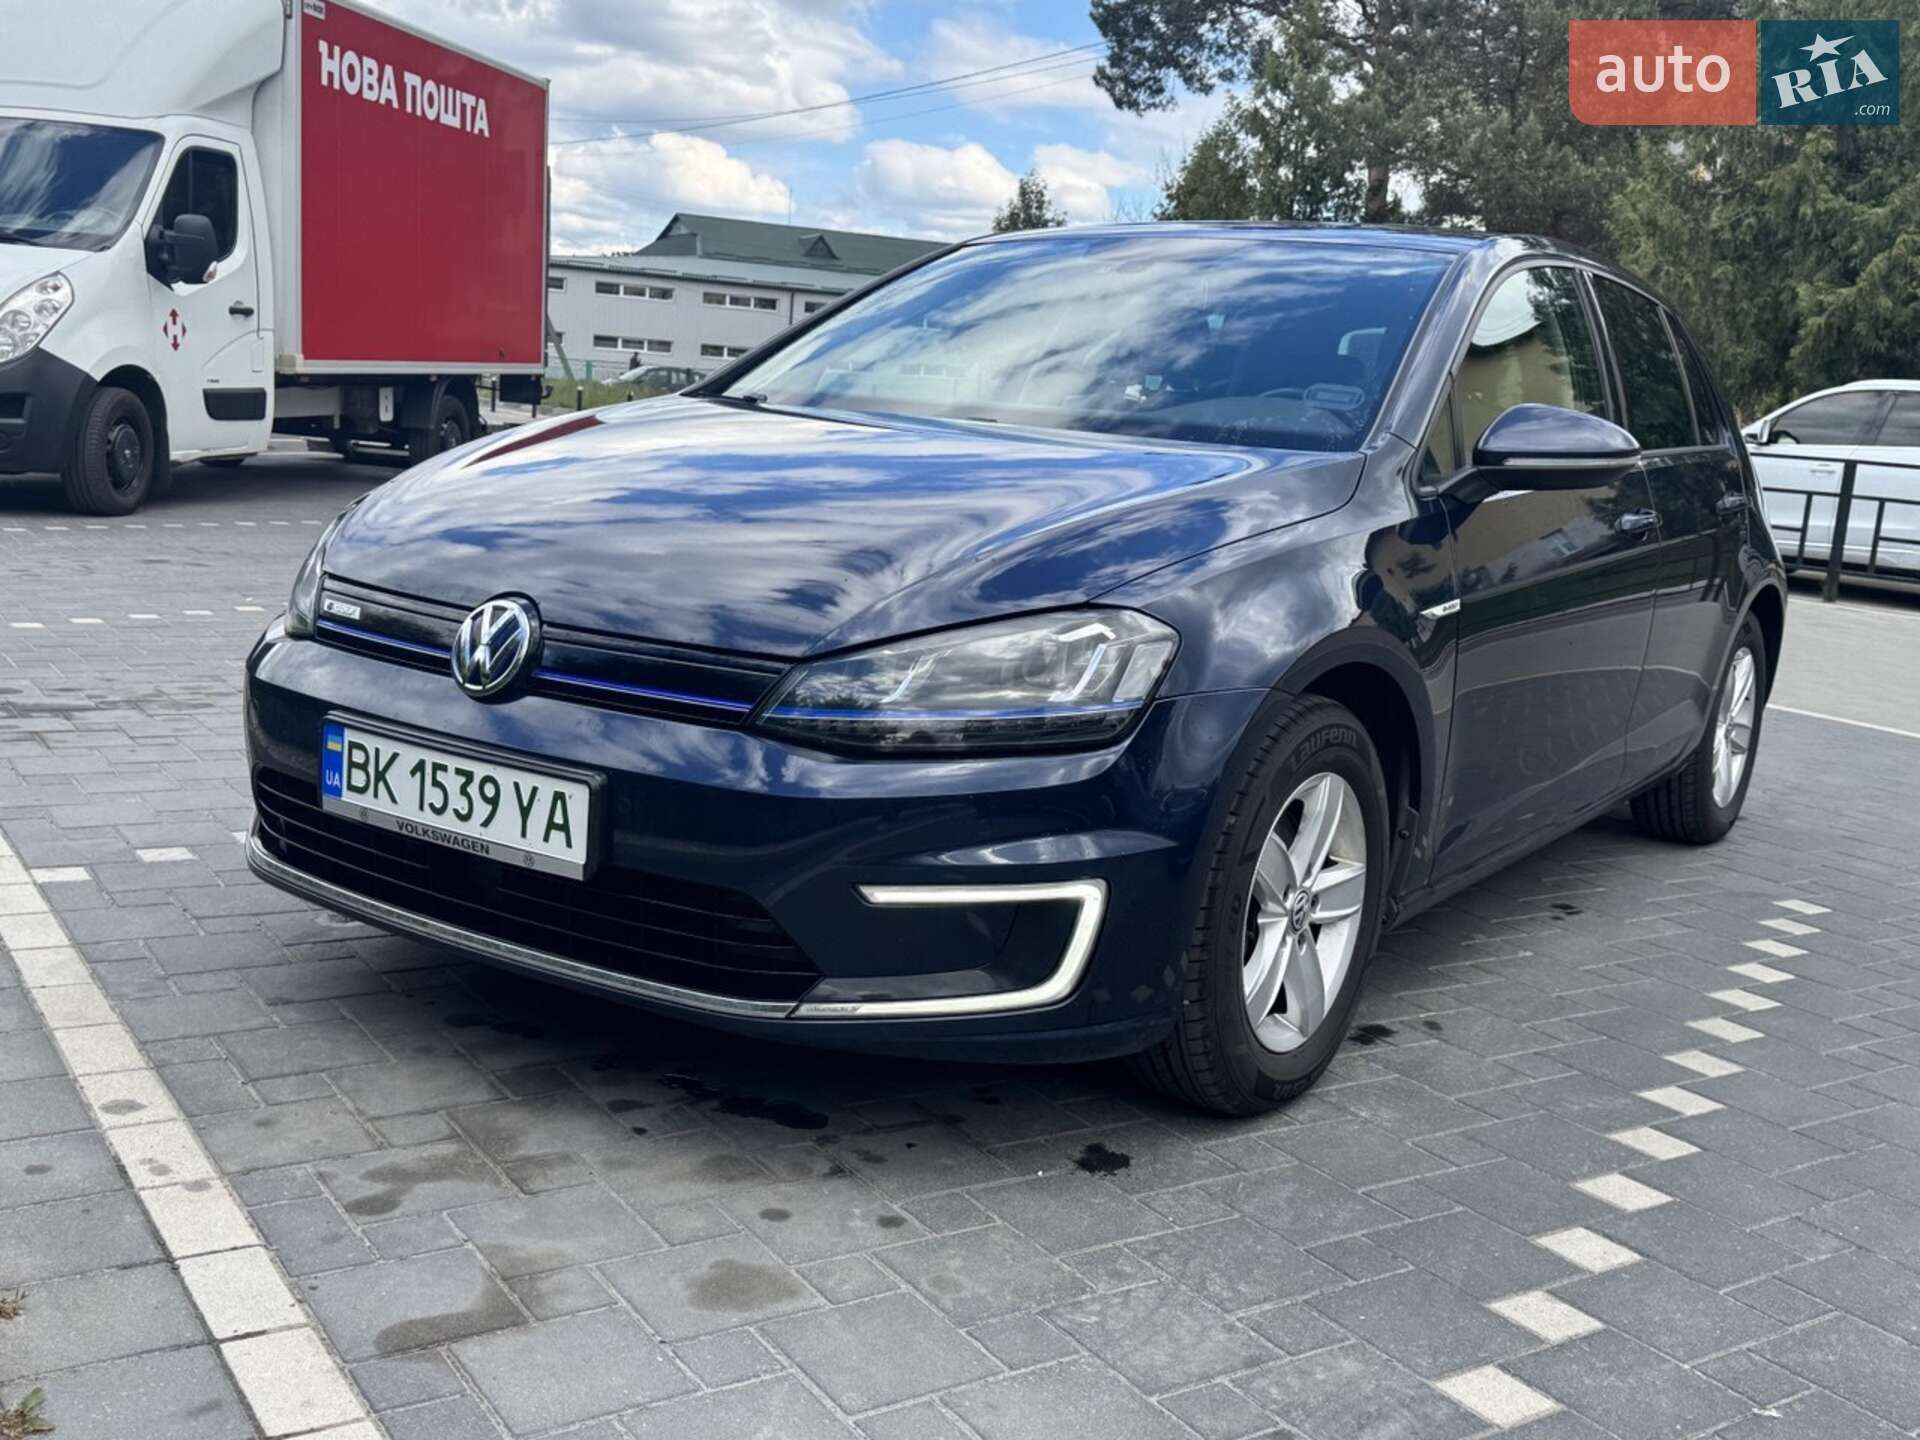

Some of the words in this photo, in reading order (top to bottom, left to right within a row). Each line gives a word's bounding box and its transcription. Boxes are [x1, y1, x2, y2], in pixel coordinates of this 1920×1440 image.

[318, 39, 400, 109] НОВА
[404, 70, 490, 138] ПОШТА
[325, 769, 341, 788] UA
[346, 740, 400, 805] BK
[409, 758, 500, 828] 1539
[513, 781, 573, 849] YA
[396, 820, 490, 856] VOLKSWAGEN
